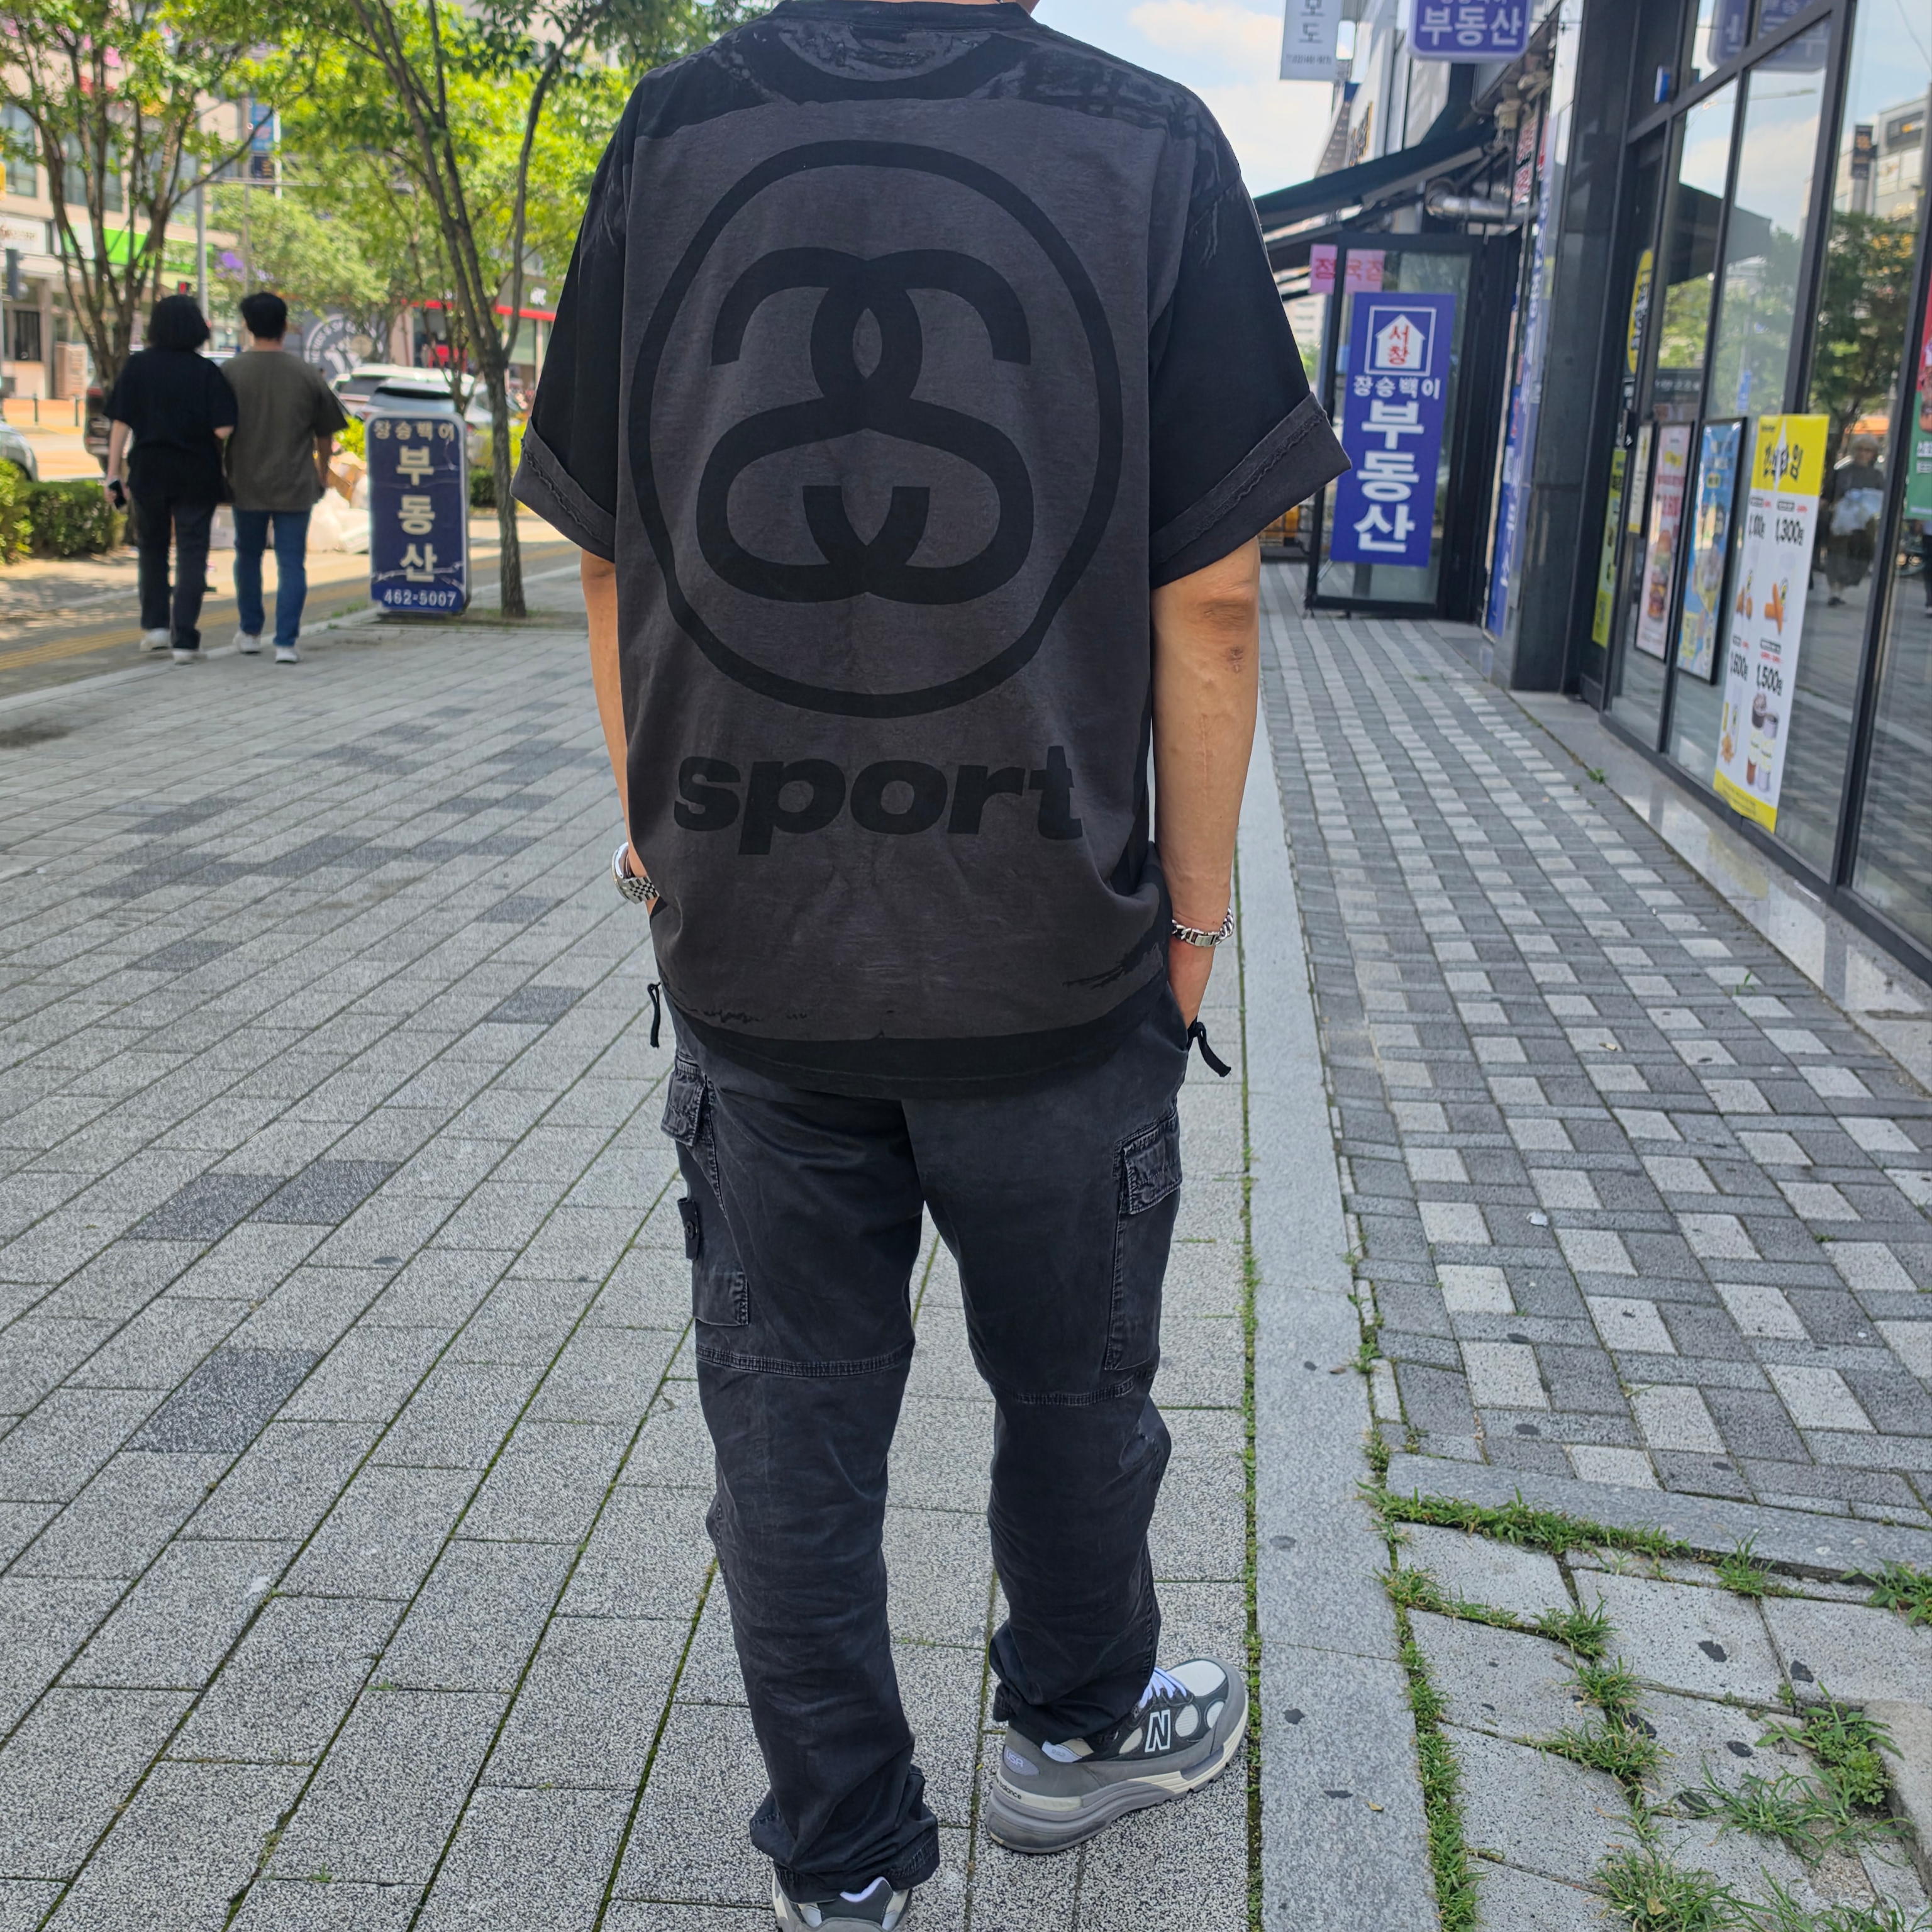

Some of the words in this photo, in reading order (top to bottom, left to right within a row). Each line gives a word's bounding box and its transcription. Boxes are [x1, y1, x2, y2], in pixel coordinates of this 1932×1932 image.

[1419, 6, 1523, 47] 부동산
[1389, 325, 1410, 365] 서창
[1353, 375, 1441, 400] 장승백이
[374, 419, 455, 441] 장승백이
[1353, 399, 1424, 553] 부동산
[396, 445, 438, 582] 부동산
[384, 588, 457, 608] 462-5007
[674, 745, 1084, 855] sport
[1145, 1709, 1171, 1753] N
[1006, 1750, 1024, 1768] USA
